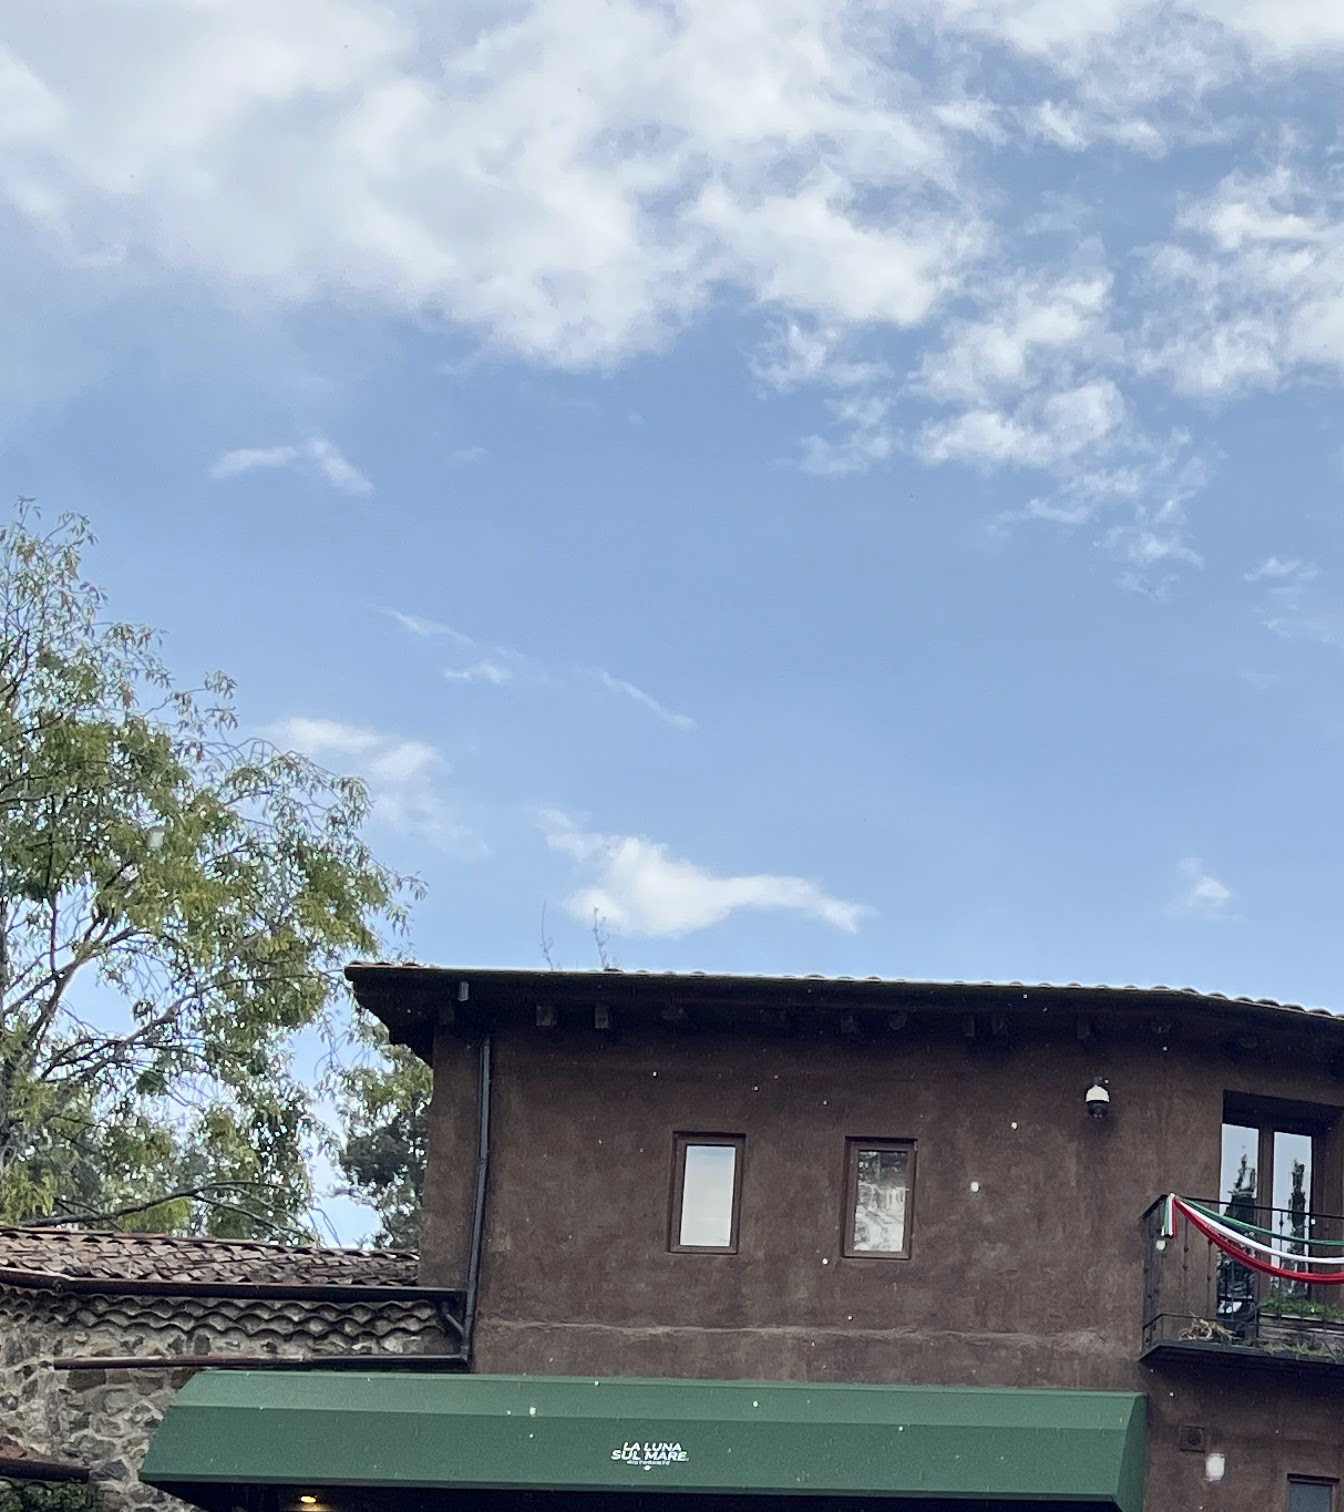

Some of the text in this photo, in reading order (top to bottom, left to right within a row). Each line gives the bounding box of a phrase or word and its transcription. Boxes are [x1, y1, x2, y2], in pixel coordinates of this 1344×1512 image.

[623, 1441, 682, 1451] LA LUNA
[611, 1449, 642, 1461] SUL
